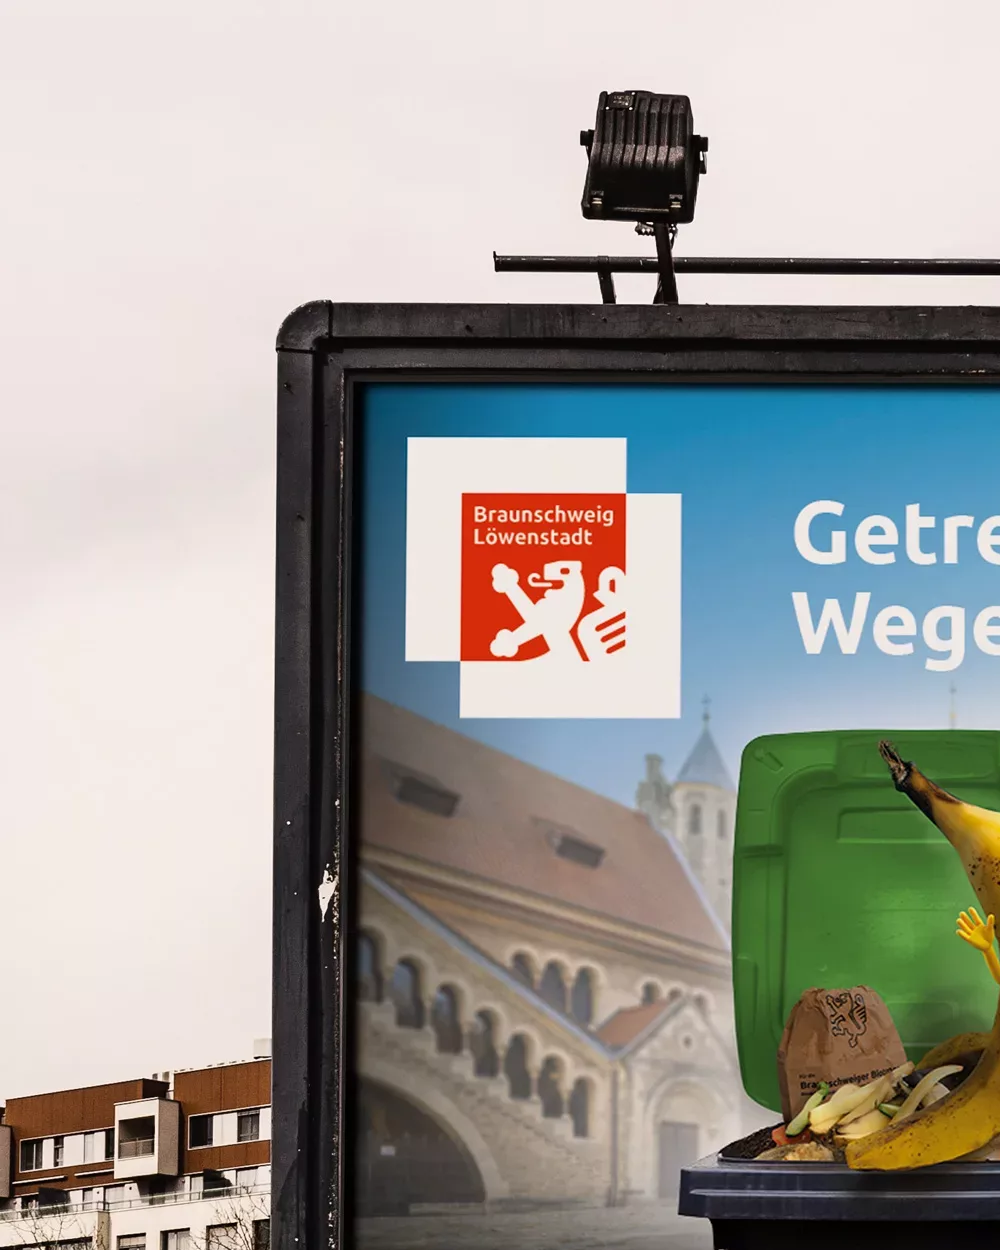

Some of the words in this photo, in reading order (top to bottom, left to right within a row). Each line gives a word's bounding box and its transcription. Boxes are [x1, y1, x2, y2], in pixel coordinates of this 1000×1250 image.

[473, 505, 614, 526] Braunschweig
[473, 528, 593, 545] Löwenstadt
[800, 1073, 869, 1090] Braschweiger
